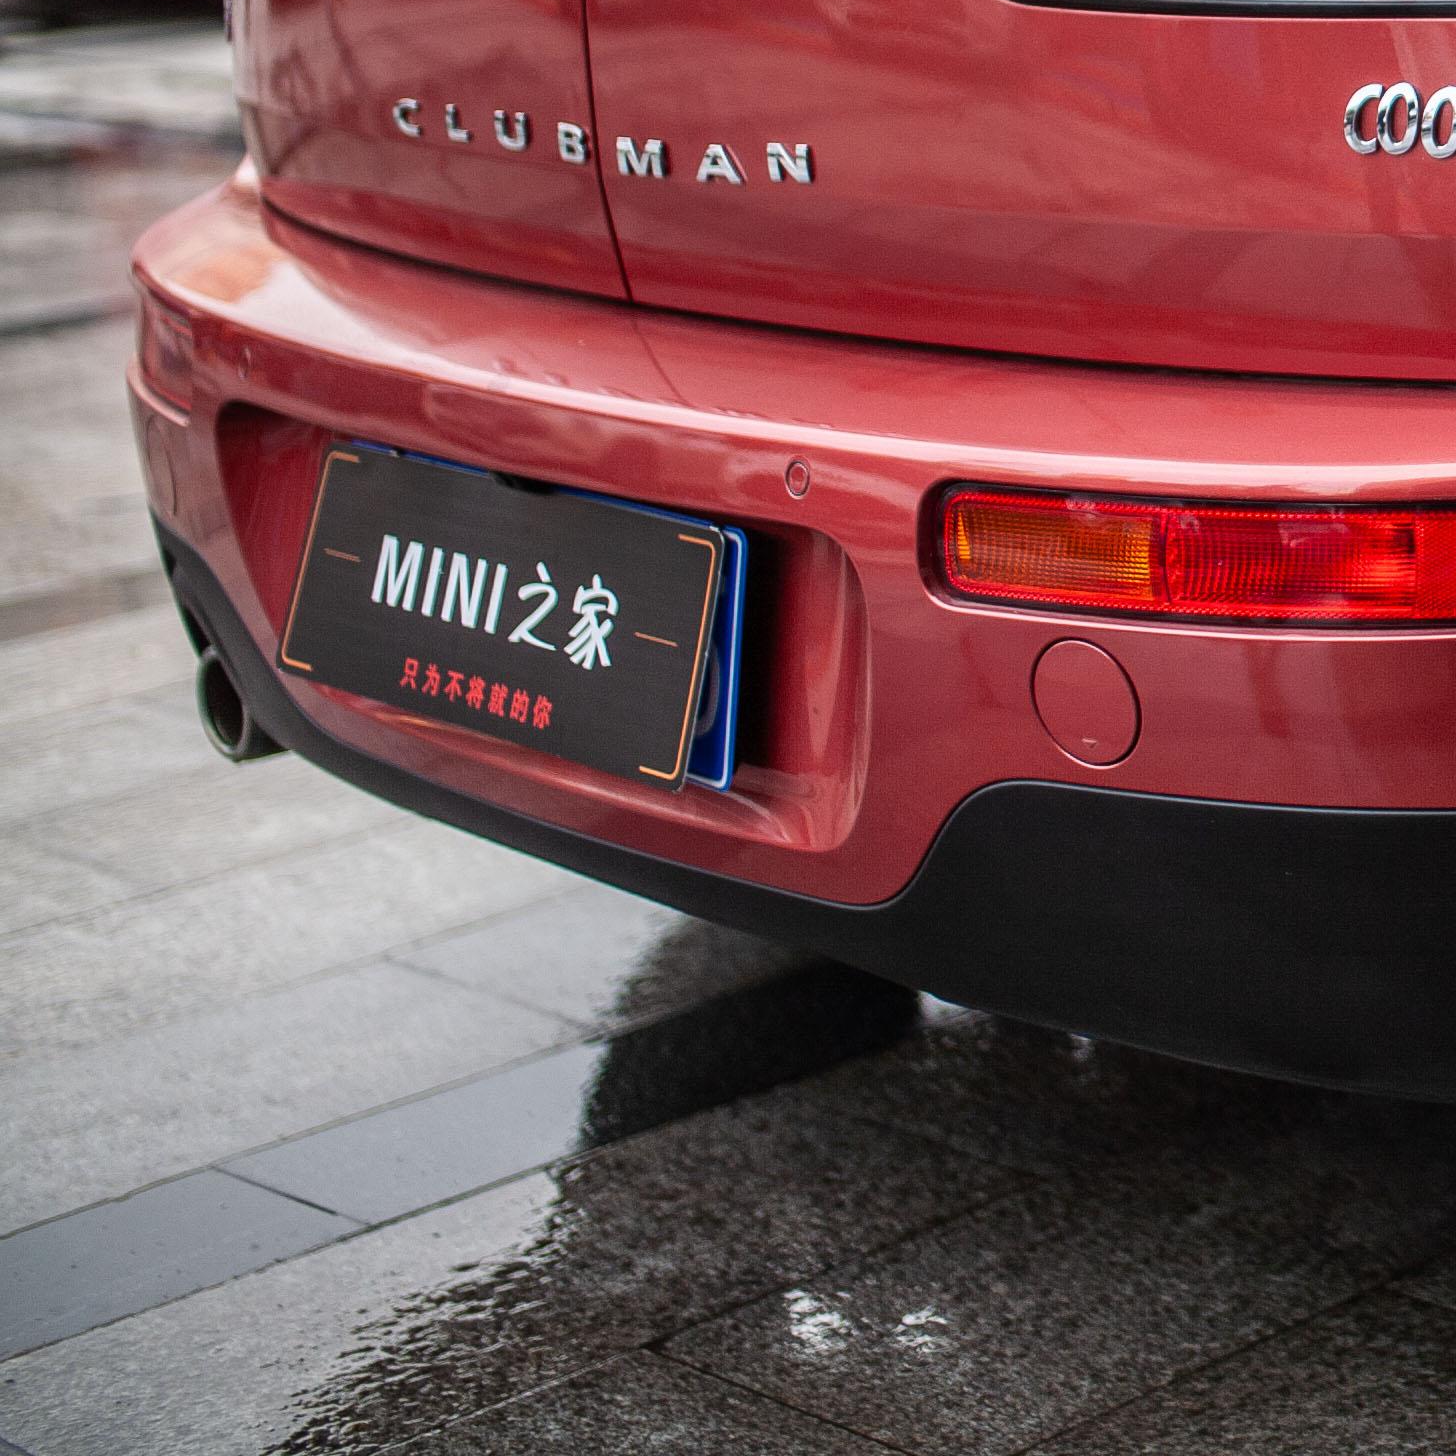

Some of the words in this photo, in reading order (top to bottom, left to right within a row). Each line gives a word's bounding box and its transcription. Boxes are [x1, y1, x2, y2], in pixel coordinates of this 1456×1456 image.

[391, 97, 815, 185] CLUBMAN
[371, 533, 620, 670] MINI之家
[399, 656, 553, 730] 只为不将就的你
